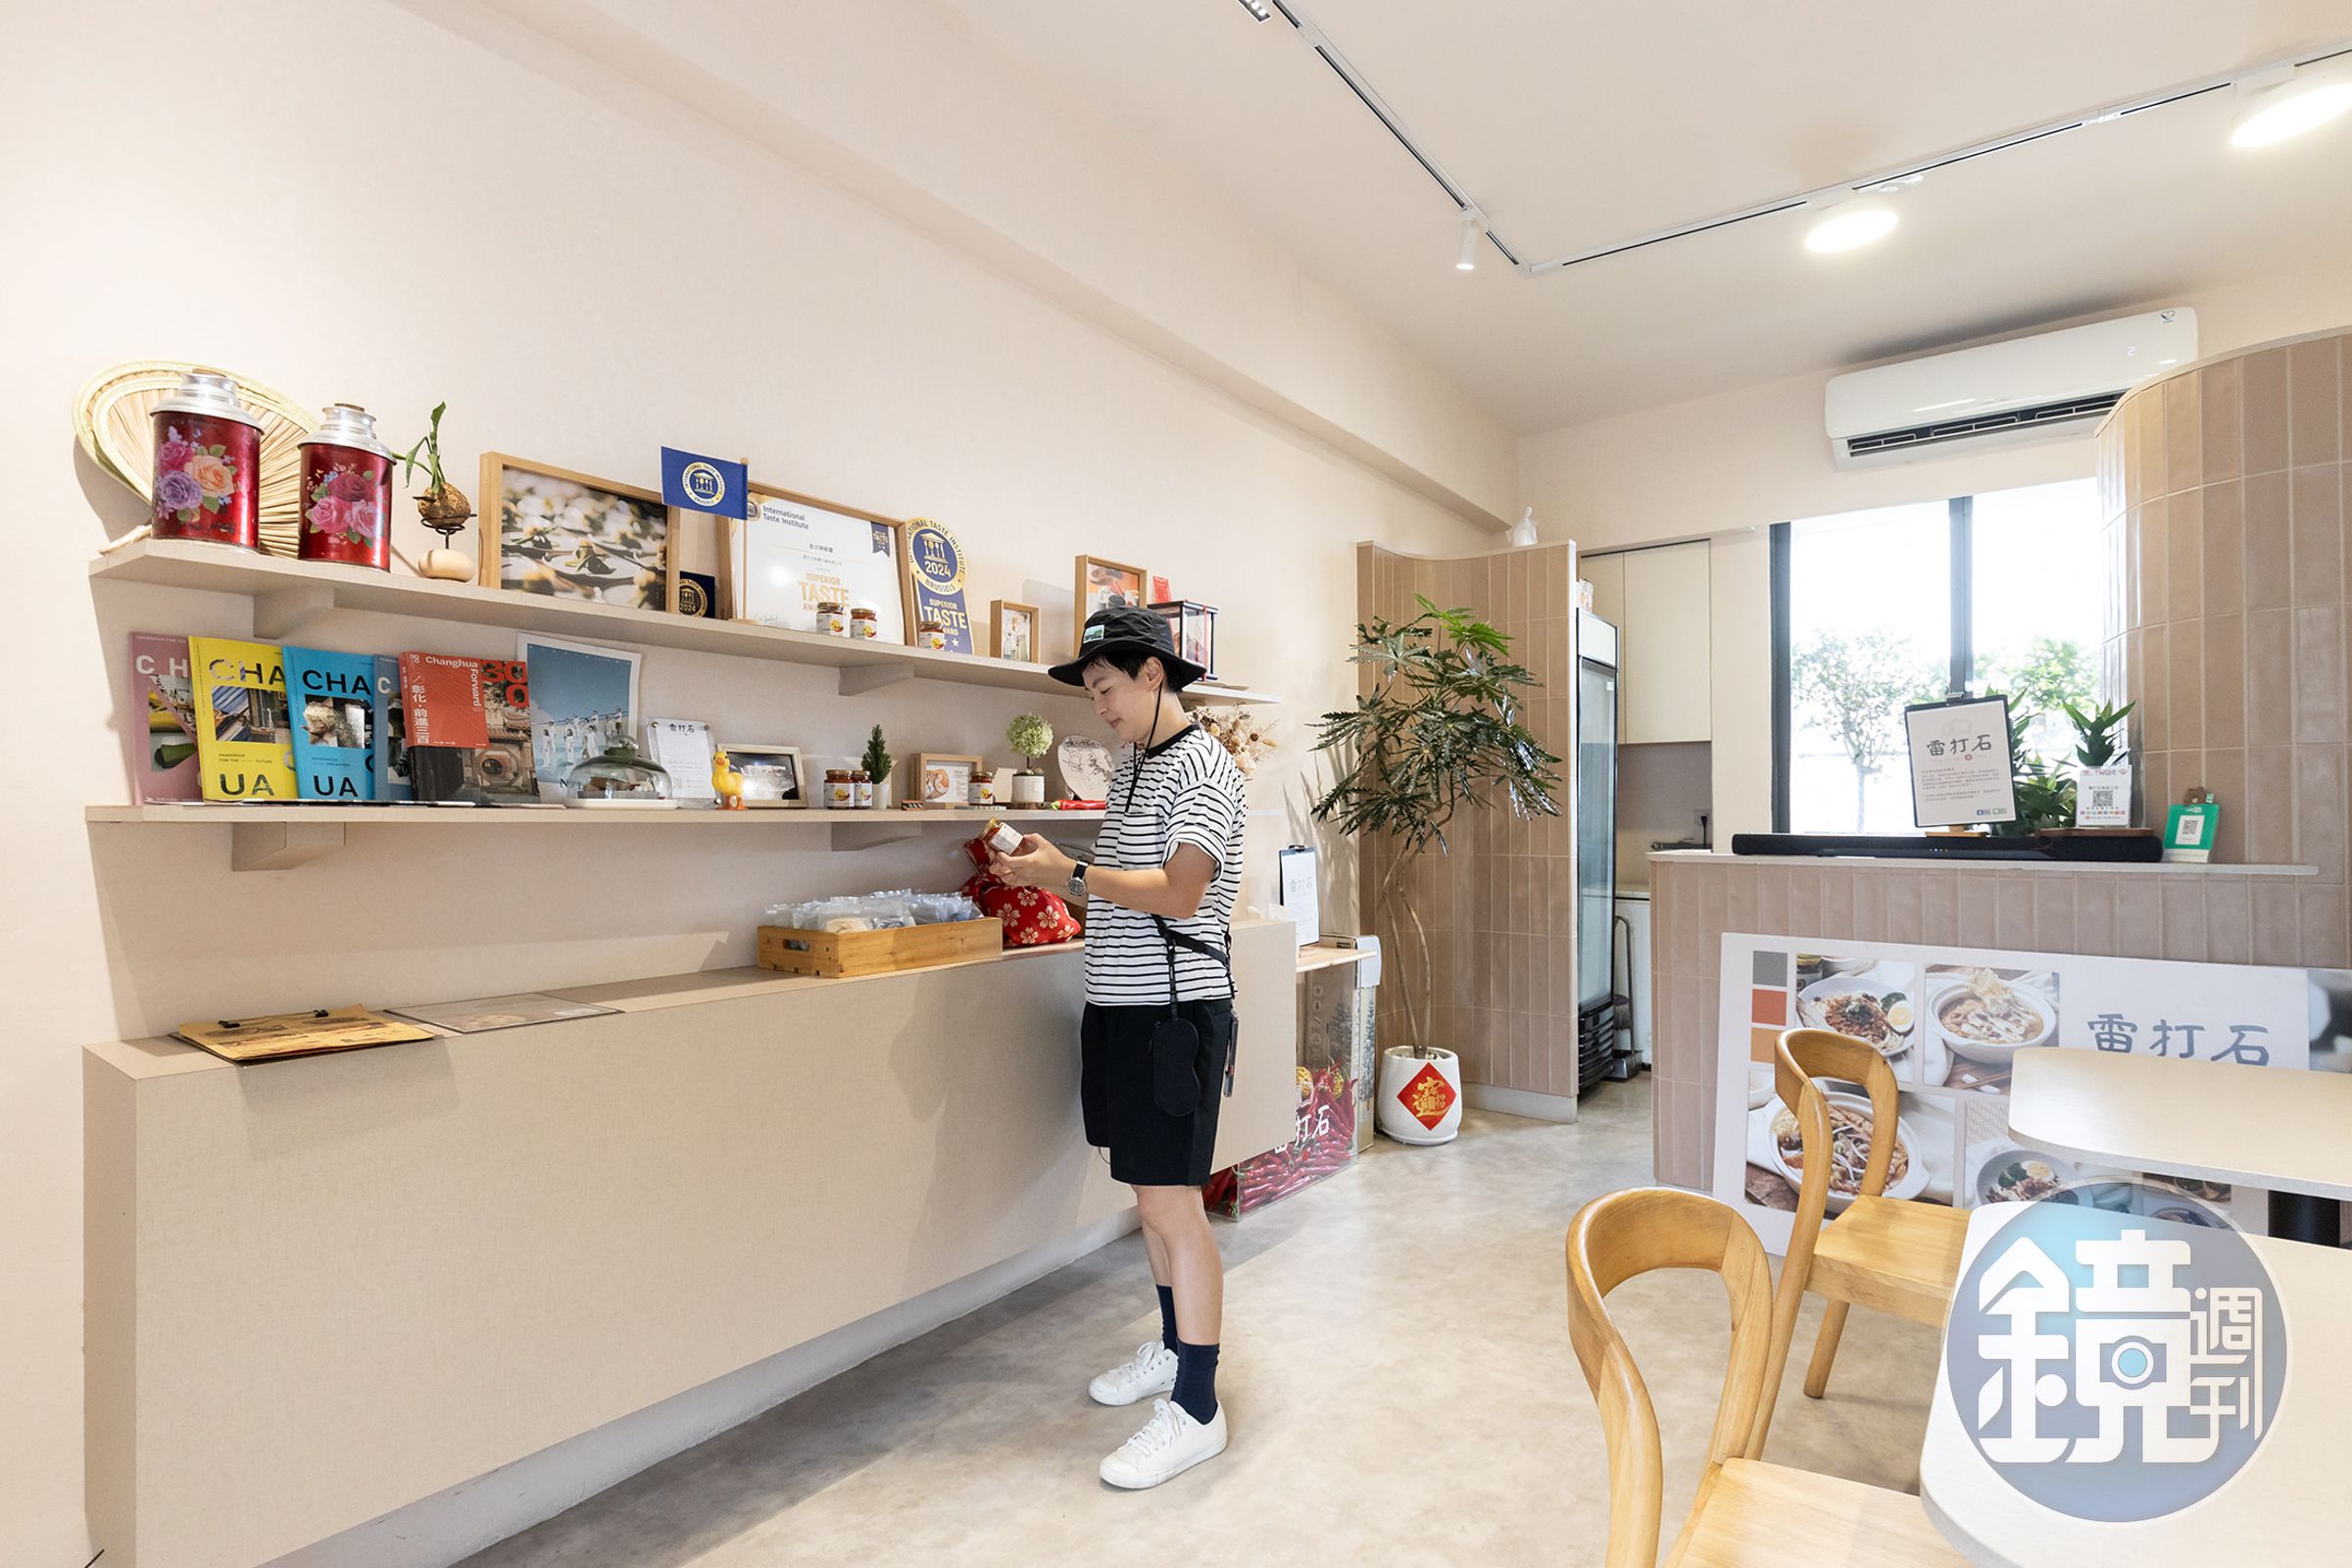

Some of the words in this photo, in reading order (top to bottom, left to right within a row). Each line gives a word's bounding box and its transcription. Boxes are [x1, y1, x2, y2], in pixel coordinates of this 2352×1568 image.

[762, 505, 806, 521] International
[763, 513, 780, 523] Taste
[781, 517, 809, 530] Institute
[930, 520, 949, 536] TASTE
[924, 560, 952, 578] 2024
[798, 580, 850, 606] TASTE
[679, 603, 696, 612] 2024
[924, 606, 968, 629] TASTE
[424, 656, 478, 668] Changhua
[302, 669, 371, 696] CHA
[470, 668, 482, 707] Forward
[1927, 733, 1992, 757] 雷打石
[220, 773, 274, 796] UA
[314, 775, 359, 798] UA
[2086, 1013, 2270, 1066] 雷打石
